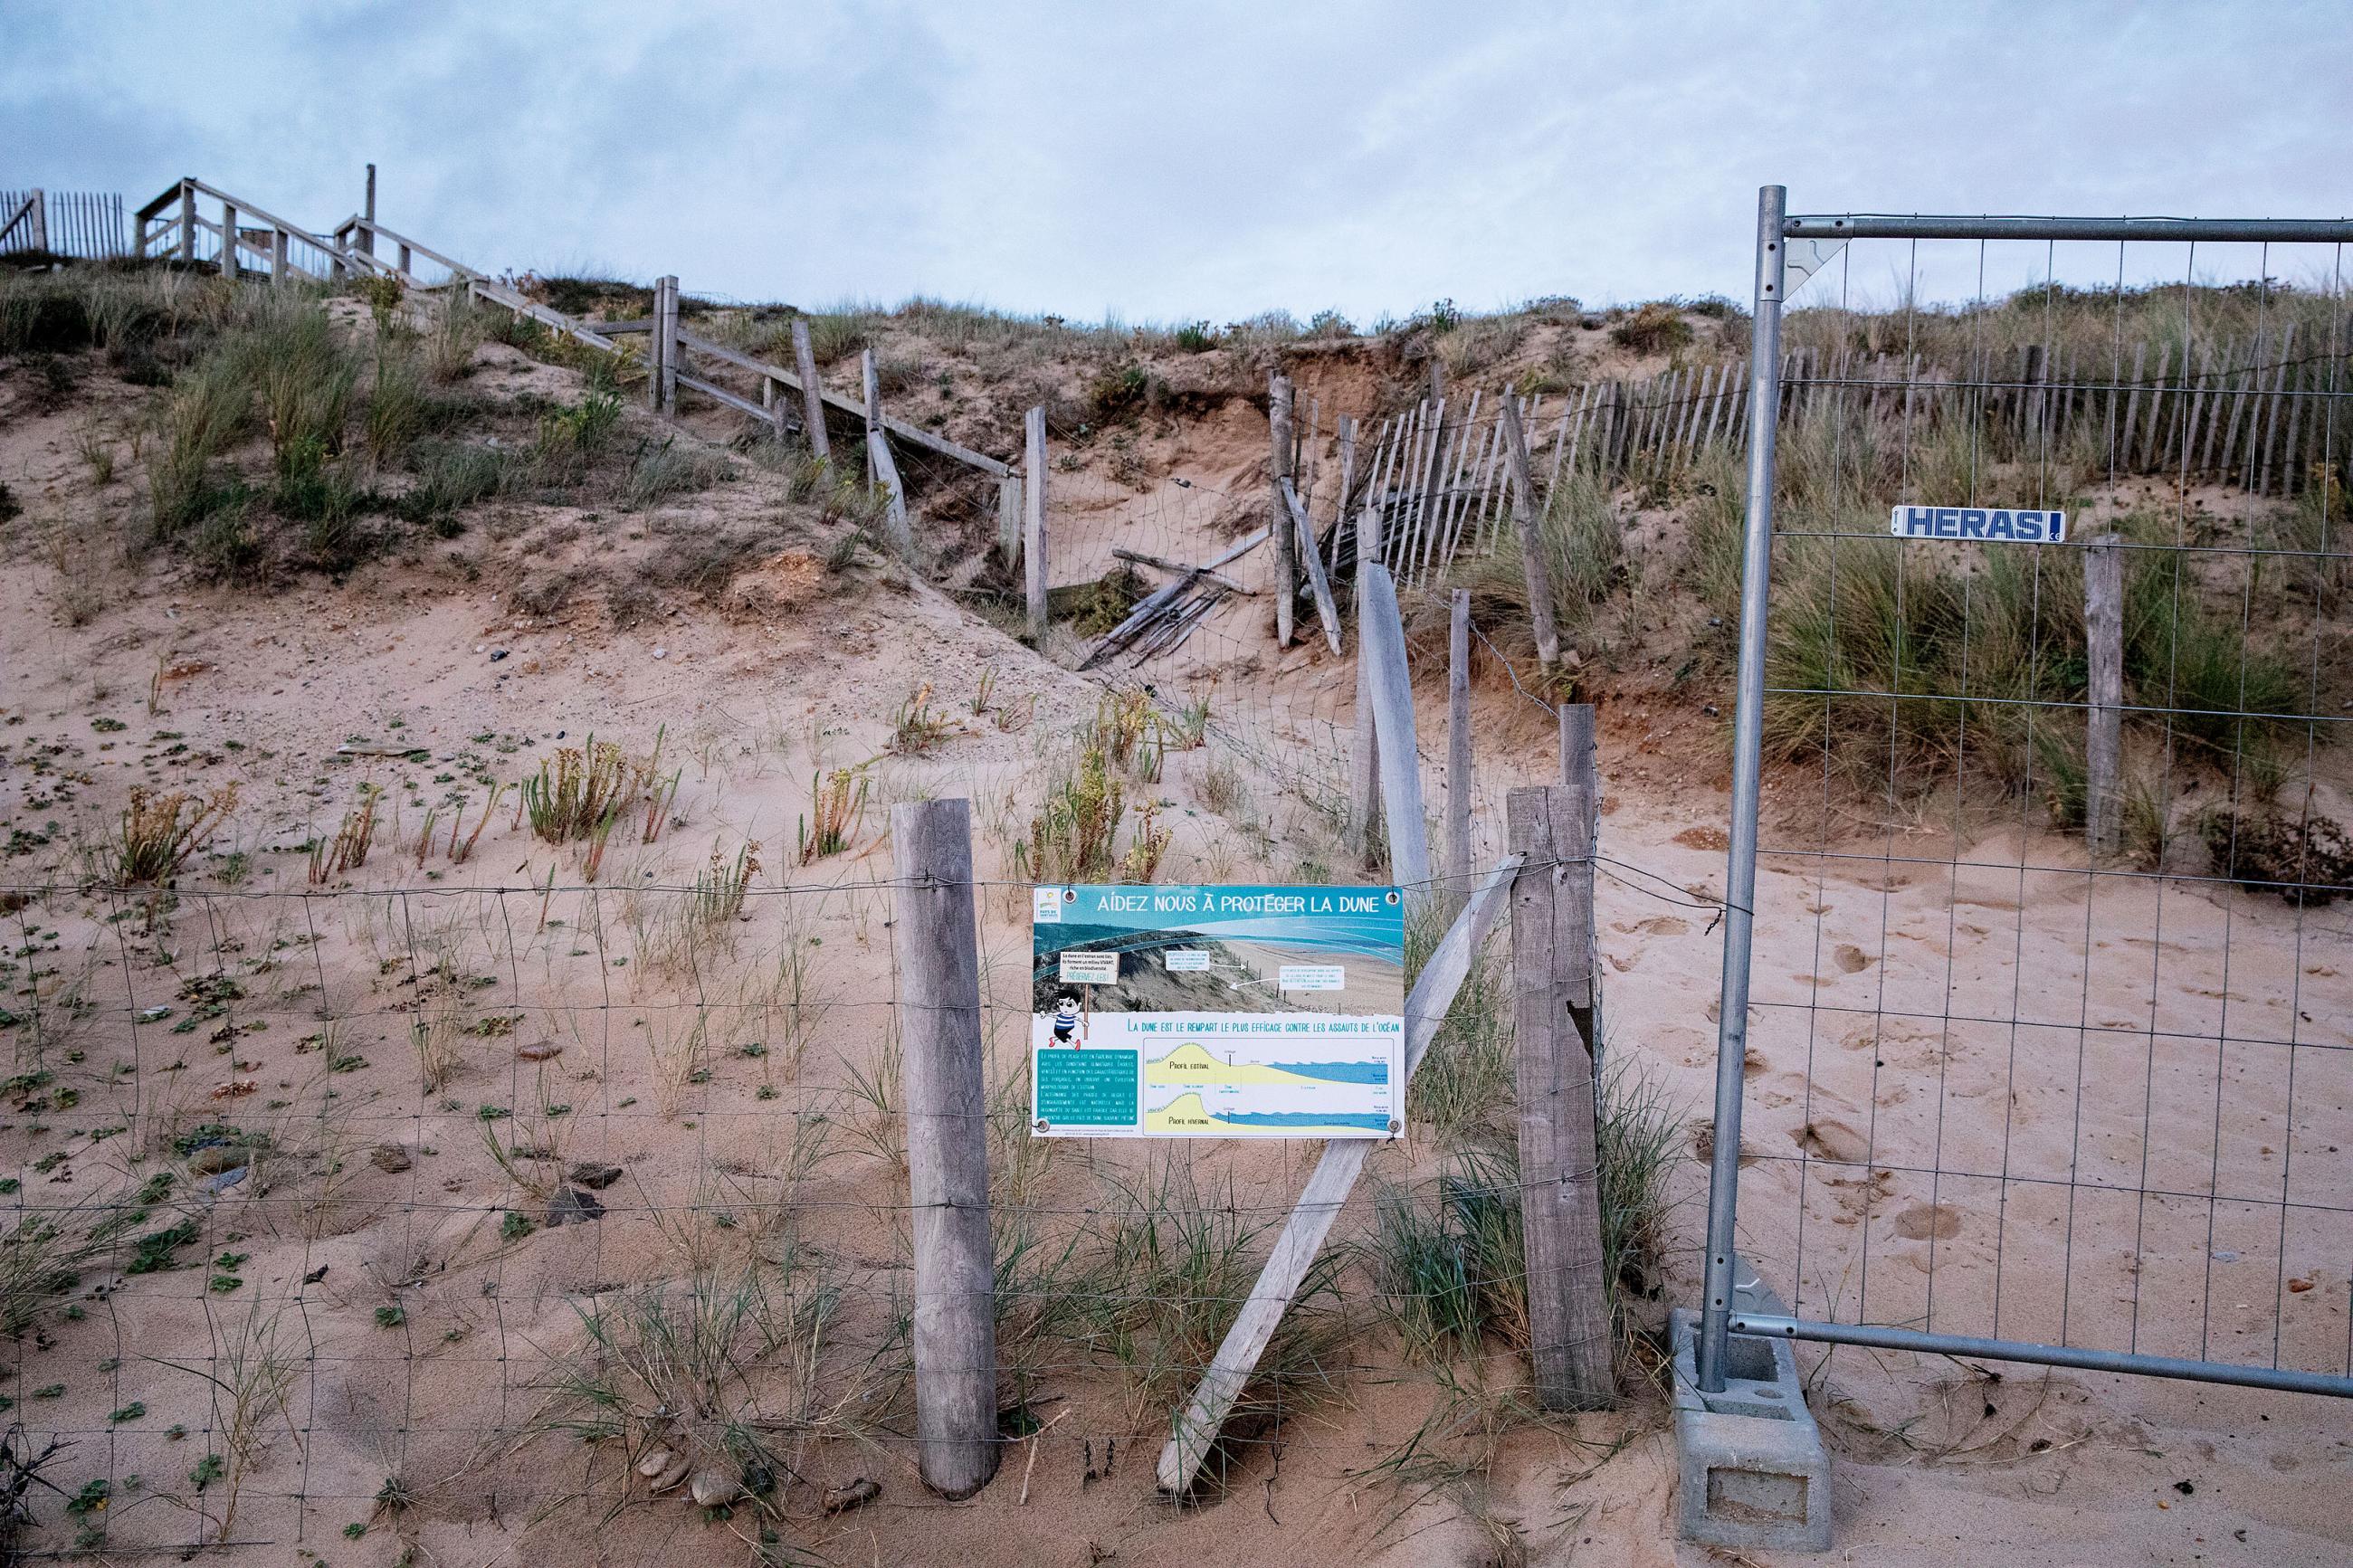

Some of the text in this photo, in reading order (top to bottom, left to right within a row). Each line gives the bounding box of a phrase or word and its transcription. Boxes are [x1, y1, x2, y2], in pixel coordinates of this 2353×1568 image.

[1907, 508, 2043, 540] HERAS
[1097, 891, 1379, 912] AIDEZ NOUS À PROTÉGER LA DUNE
[1141, 1022, 1157, 1032] DUNE
[1161, 1022, 1173, 1032] EST
[1176, 1022, 1185, 1032] LE
[1187, 1022, 1217, 1032] REMPART
[1221, 1022, 1229, 1032] LE
[1232, 1022, 1249, 1032] PLUS
[1252, 1022, 1281, 1032] EFFICACE
[1285, 1022, 1310, 1032] CONTRE
[1313, 1022, 1326, 1032] LES
[1329, 1022, 1358, 1032] ASSAUTS
[1361, 1022, 1370, 1032] DE
[1373, 1021, 1400, 1032] L'OCÉAN
